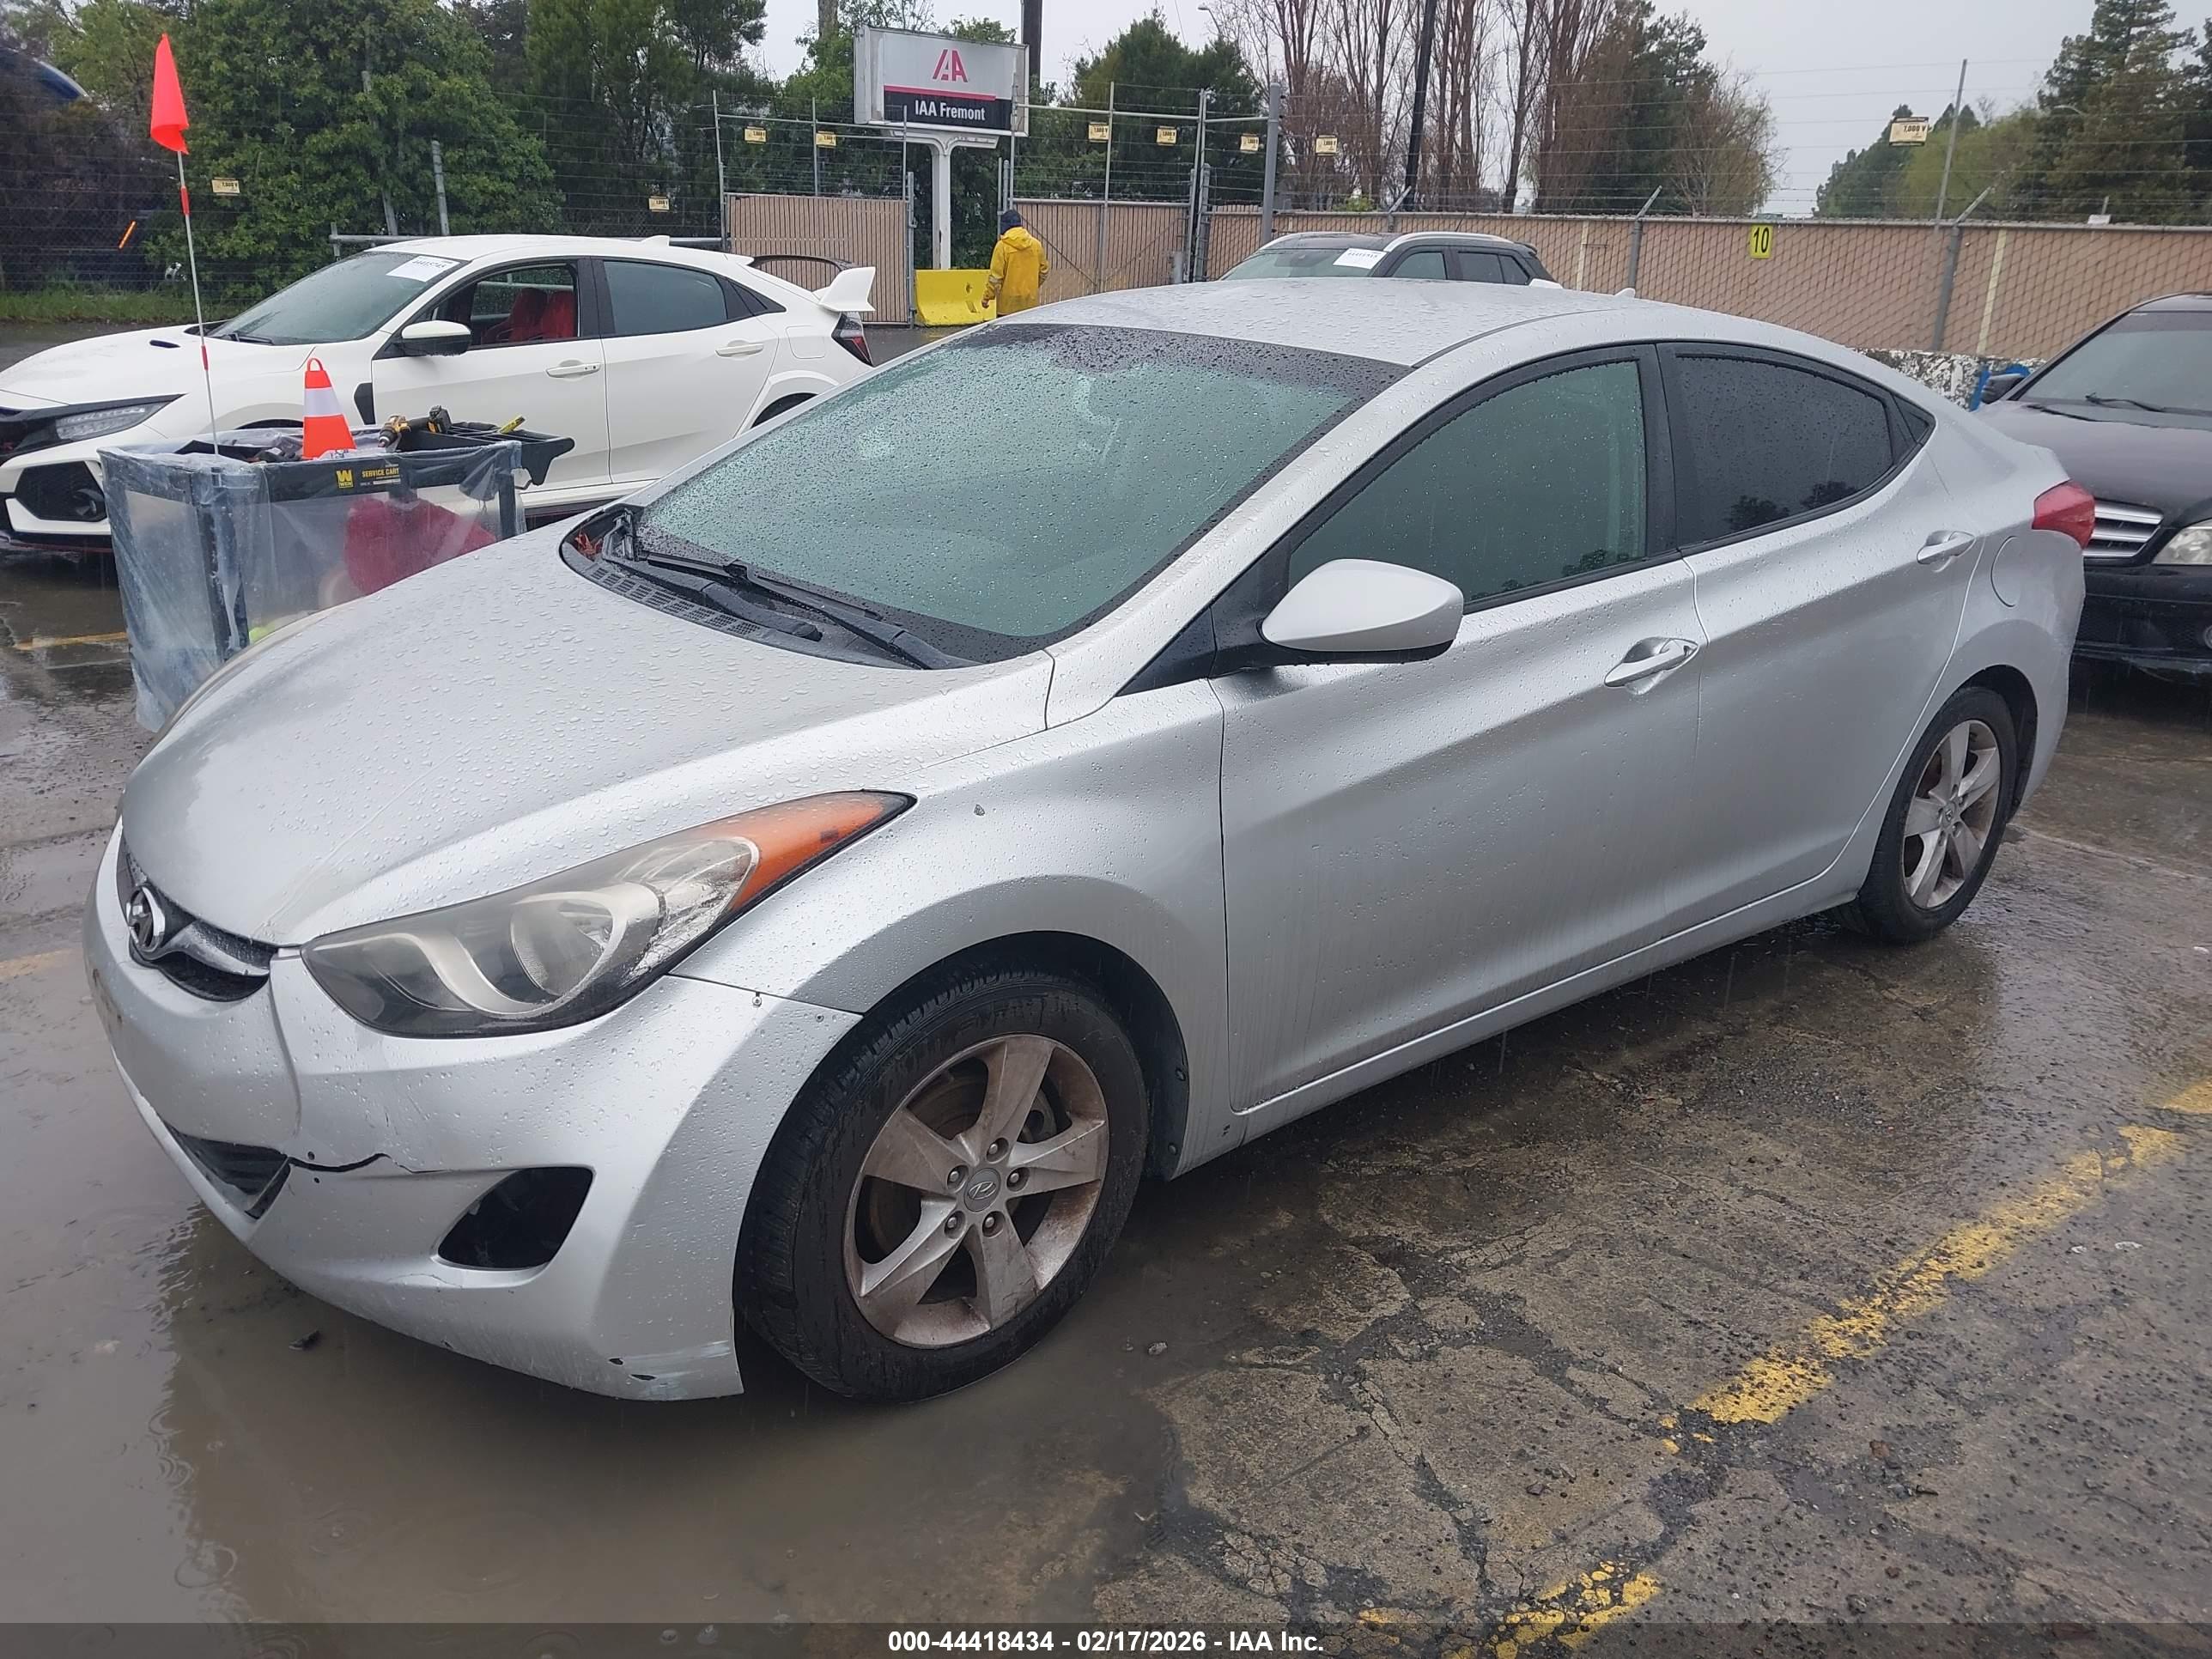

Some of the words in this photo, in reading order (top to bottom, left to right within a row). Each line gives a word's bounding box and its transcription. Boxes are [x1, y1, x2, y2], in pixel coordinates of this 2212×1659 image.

[915, 100, 937, 117] IAA
[939, 102, 986, 121] Fremont
[1753, 227, 1769, 253] 10
